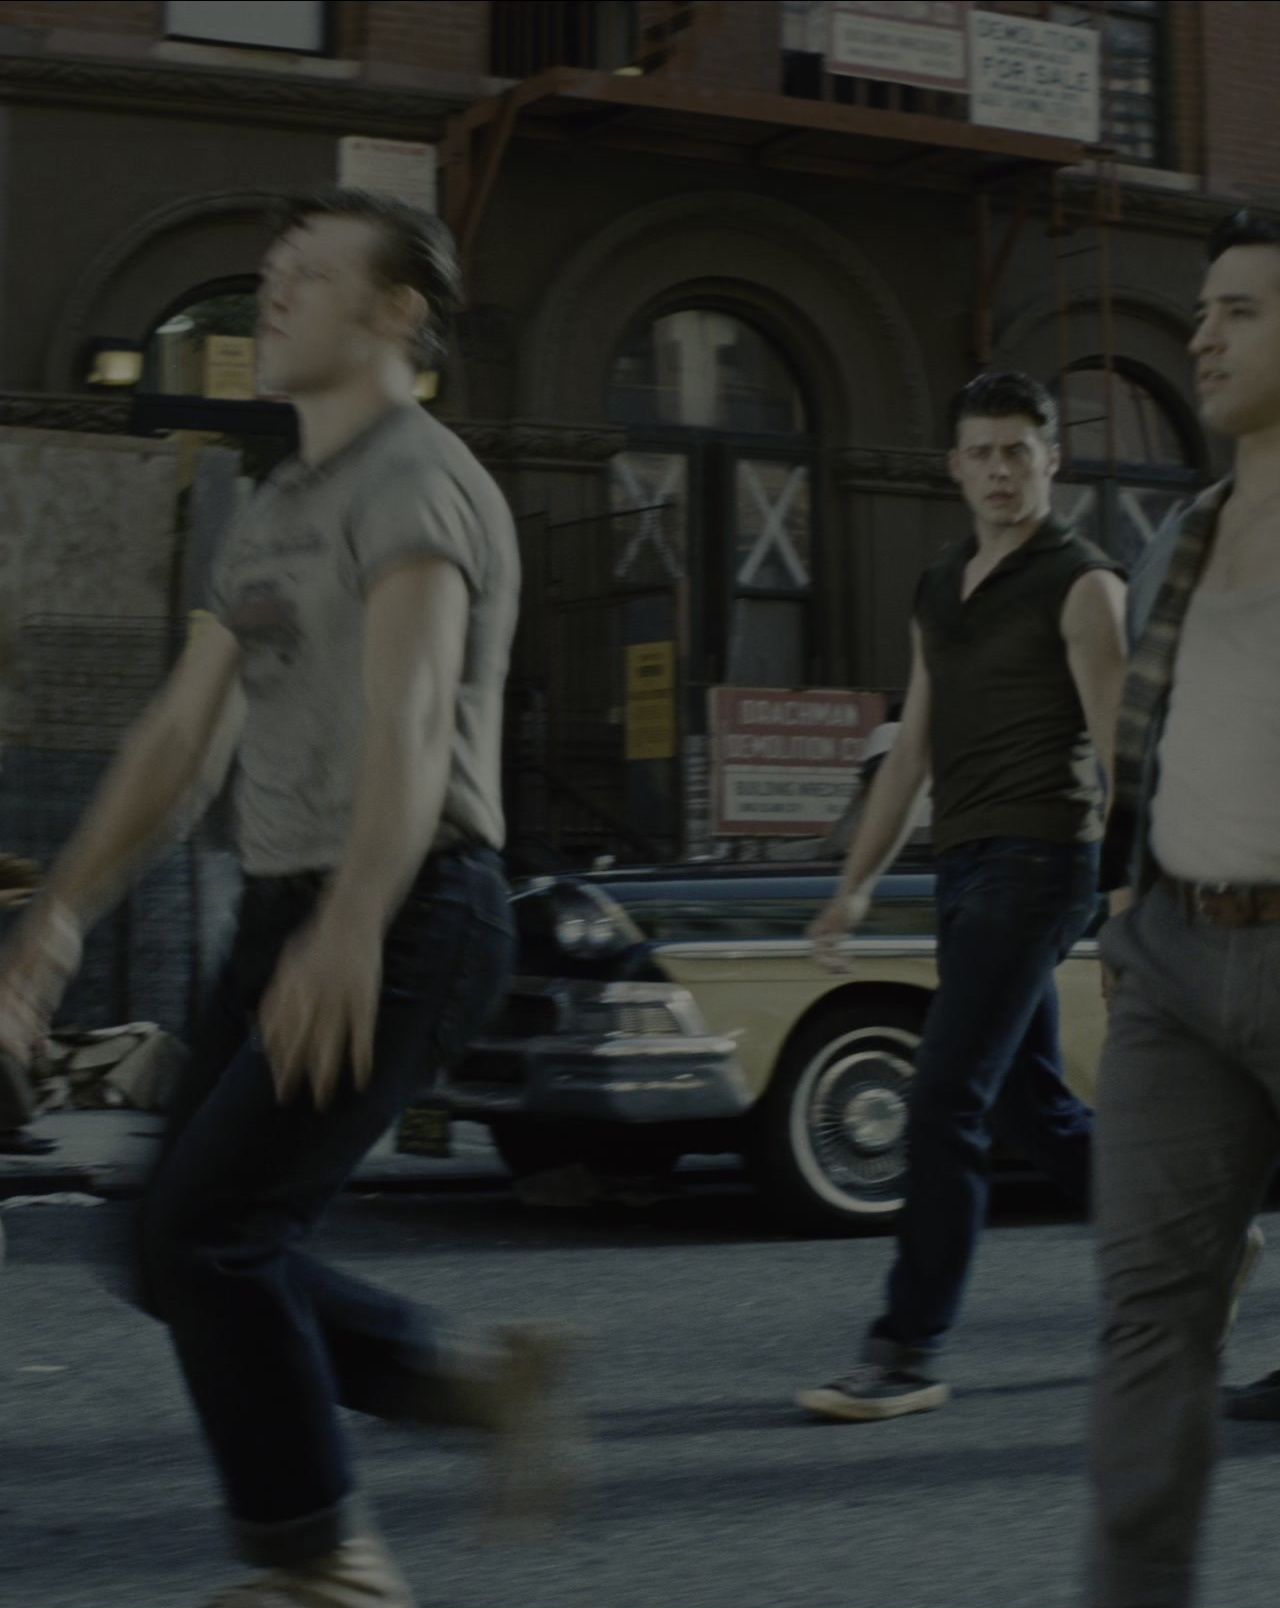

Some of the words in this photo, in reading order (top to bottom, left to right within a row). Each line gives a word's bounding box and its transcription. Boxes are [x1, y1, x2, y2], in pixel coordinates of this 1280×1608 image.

[983, 55, 1025, 79] FOR
[1034, 65, 1090, 92] SALE
[726, 733, 835, 760] DEMOLITION
